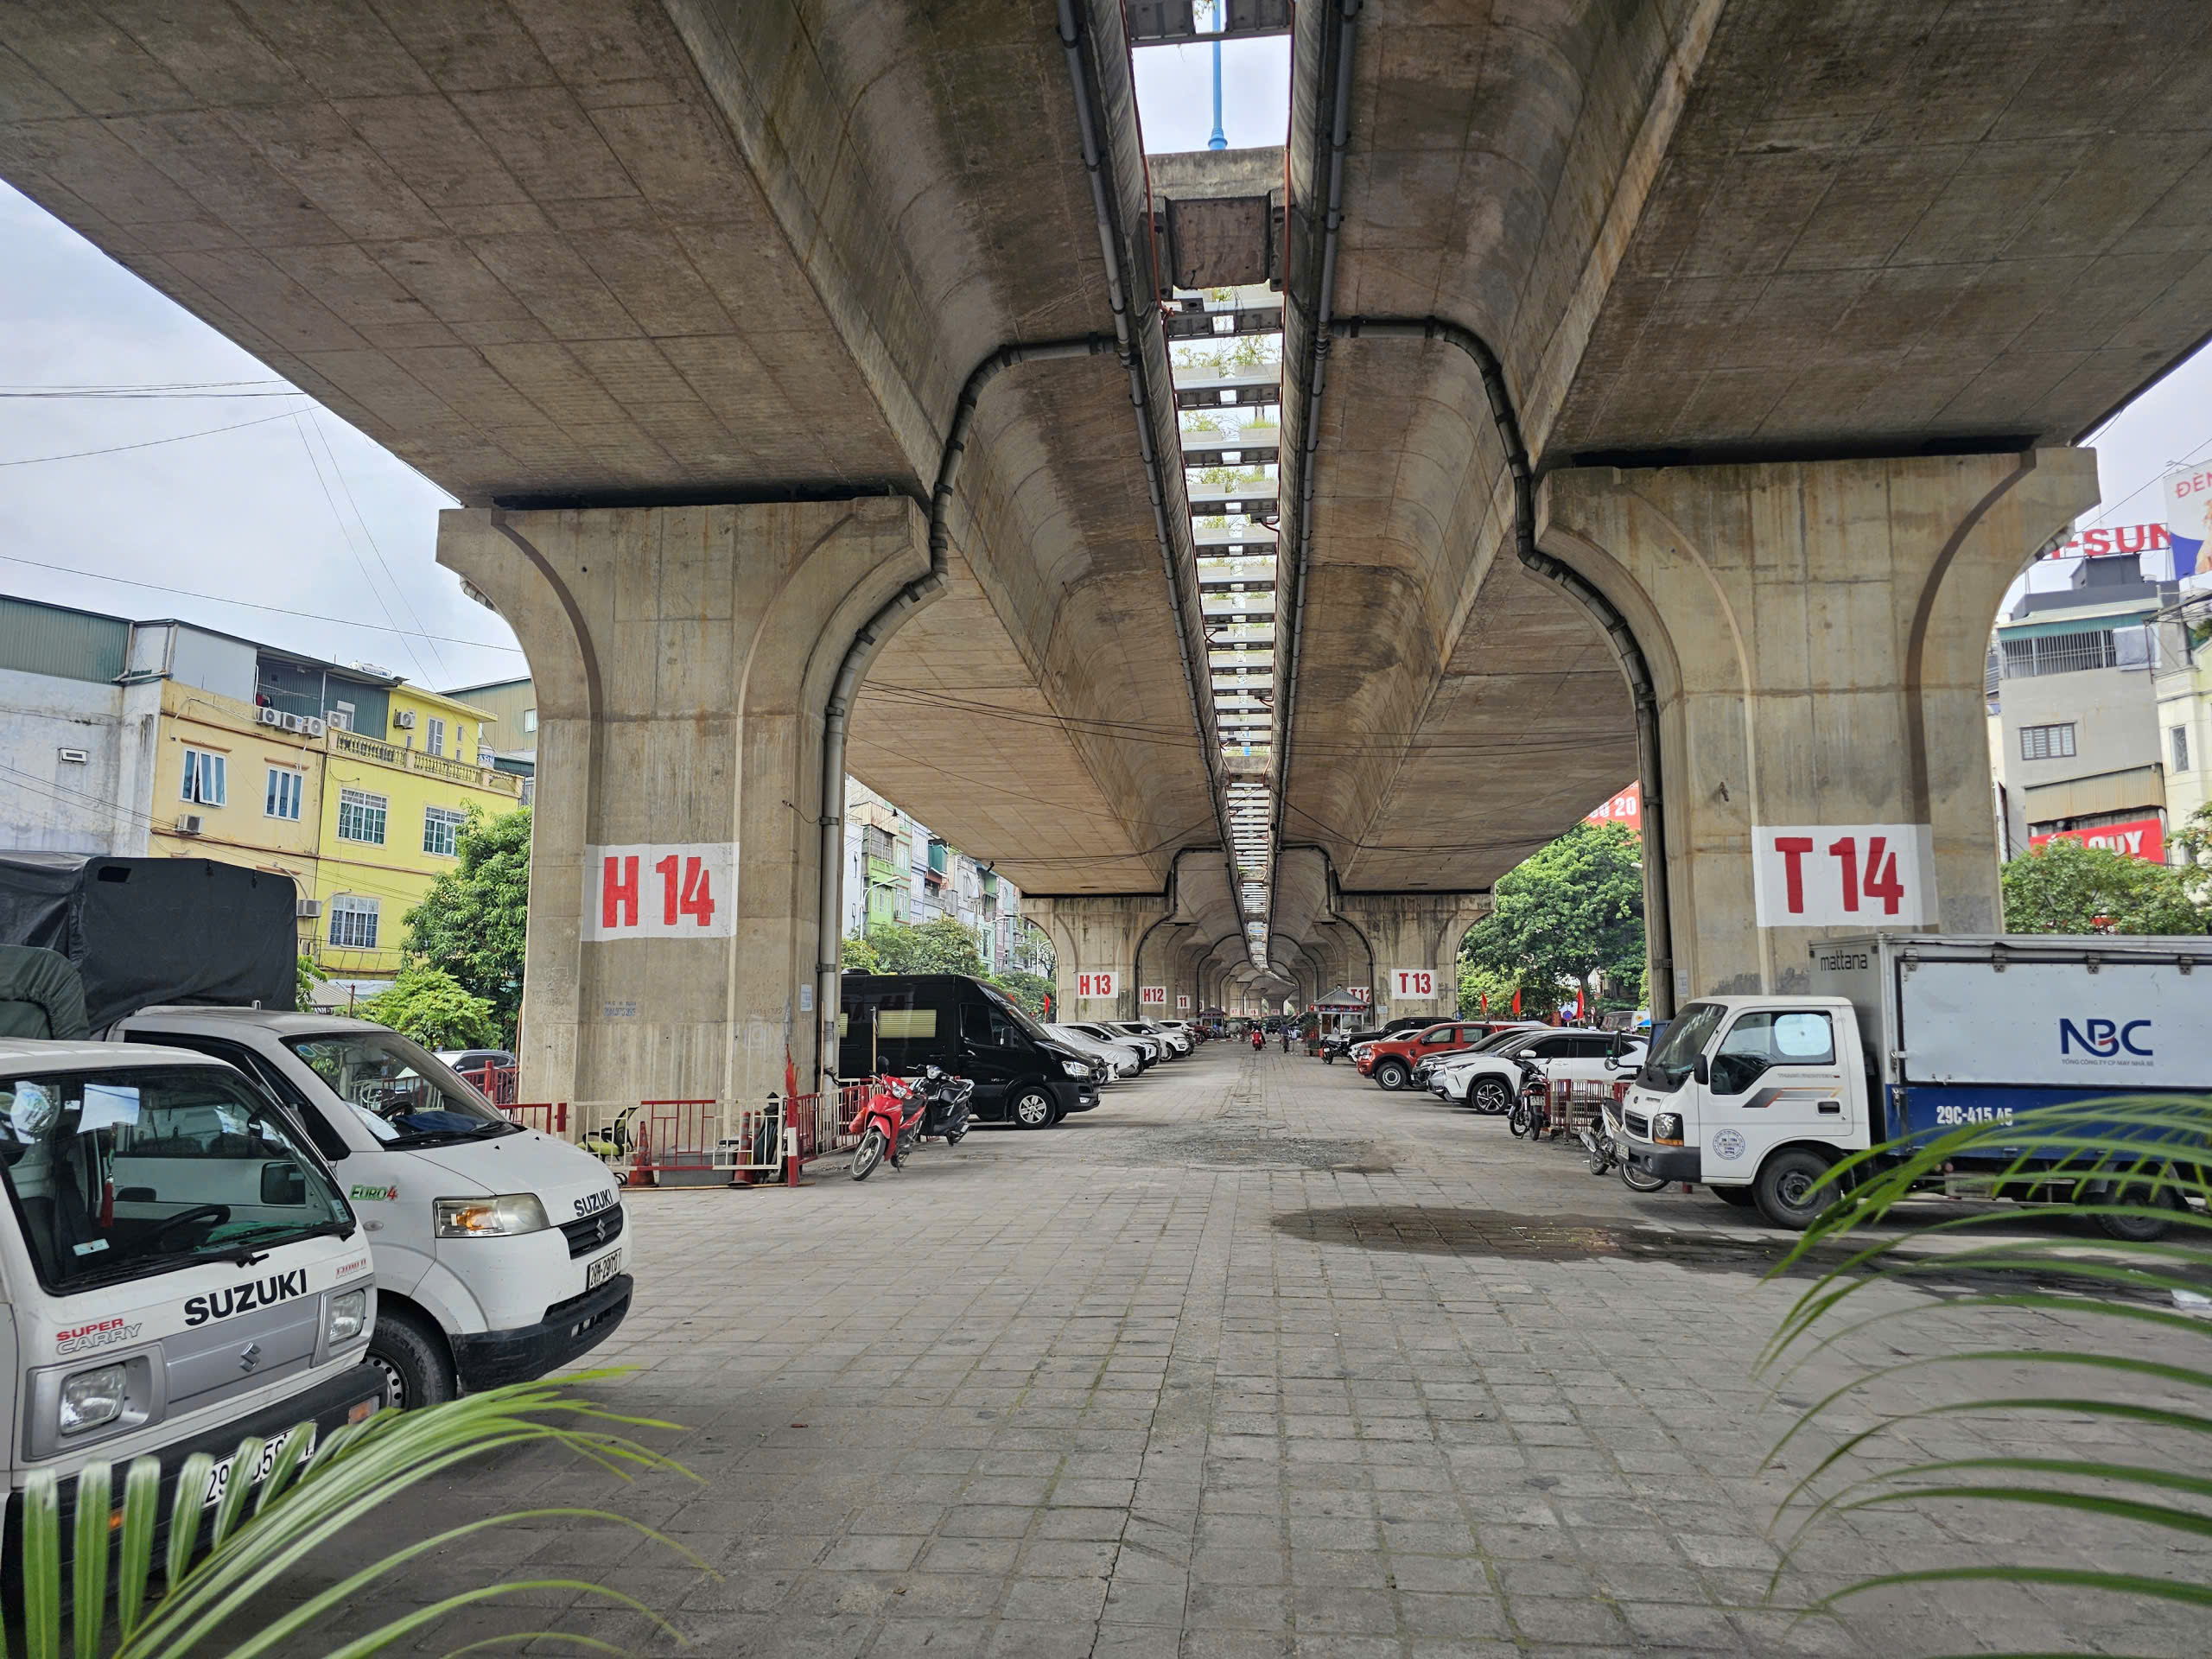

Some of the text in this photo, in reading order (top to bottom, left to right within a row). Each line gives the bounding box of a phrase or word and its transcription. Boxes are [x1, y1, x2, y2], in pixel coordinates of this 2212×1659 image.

[2053, 524, 2171, 559] -SUN
[1614, 798, 1637, 816] 20
[1775, 837, 1904, 914] T 14
[602, 855, 715, 928] H 14
[1821, 950, 1868, 971] mattana
[1094, 975, 1110, 995] 13
[1413, 973, 1431, 994] 13
[2060, 1019, 2153, 1057] NBC
[1936, 1105, 2013, 1126] 29C-41545
[574, 1189, 613, 1217] SUZUKI
[184, 1268, 308, 1326] SUZUKI
[56, 1319, 124, 1342] SUPER
[57, 1323, 143, 1355] CARRY
